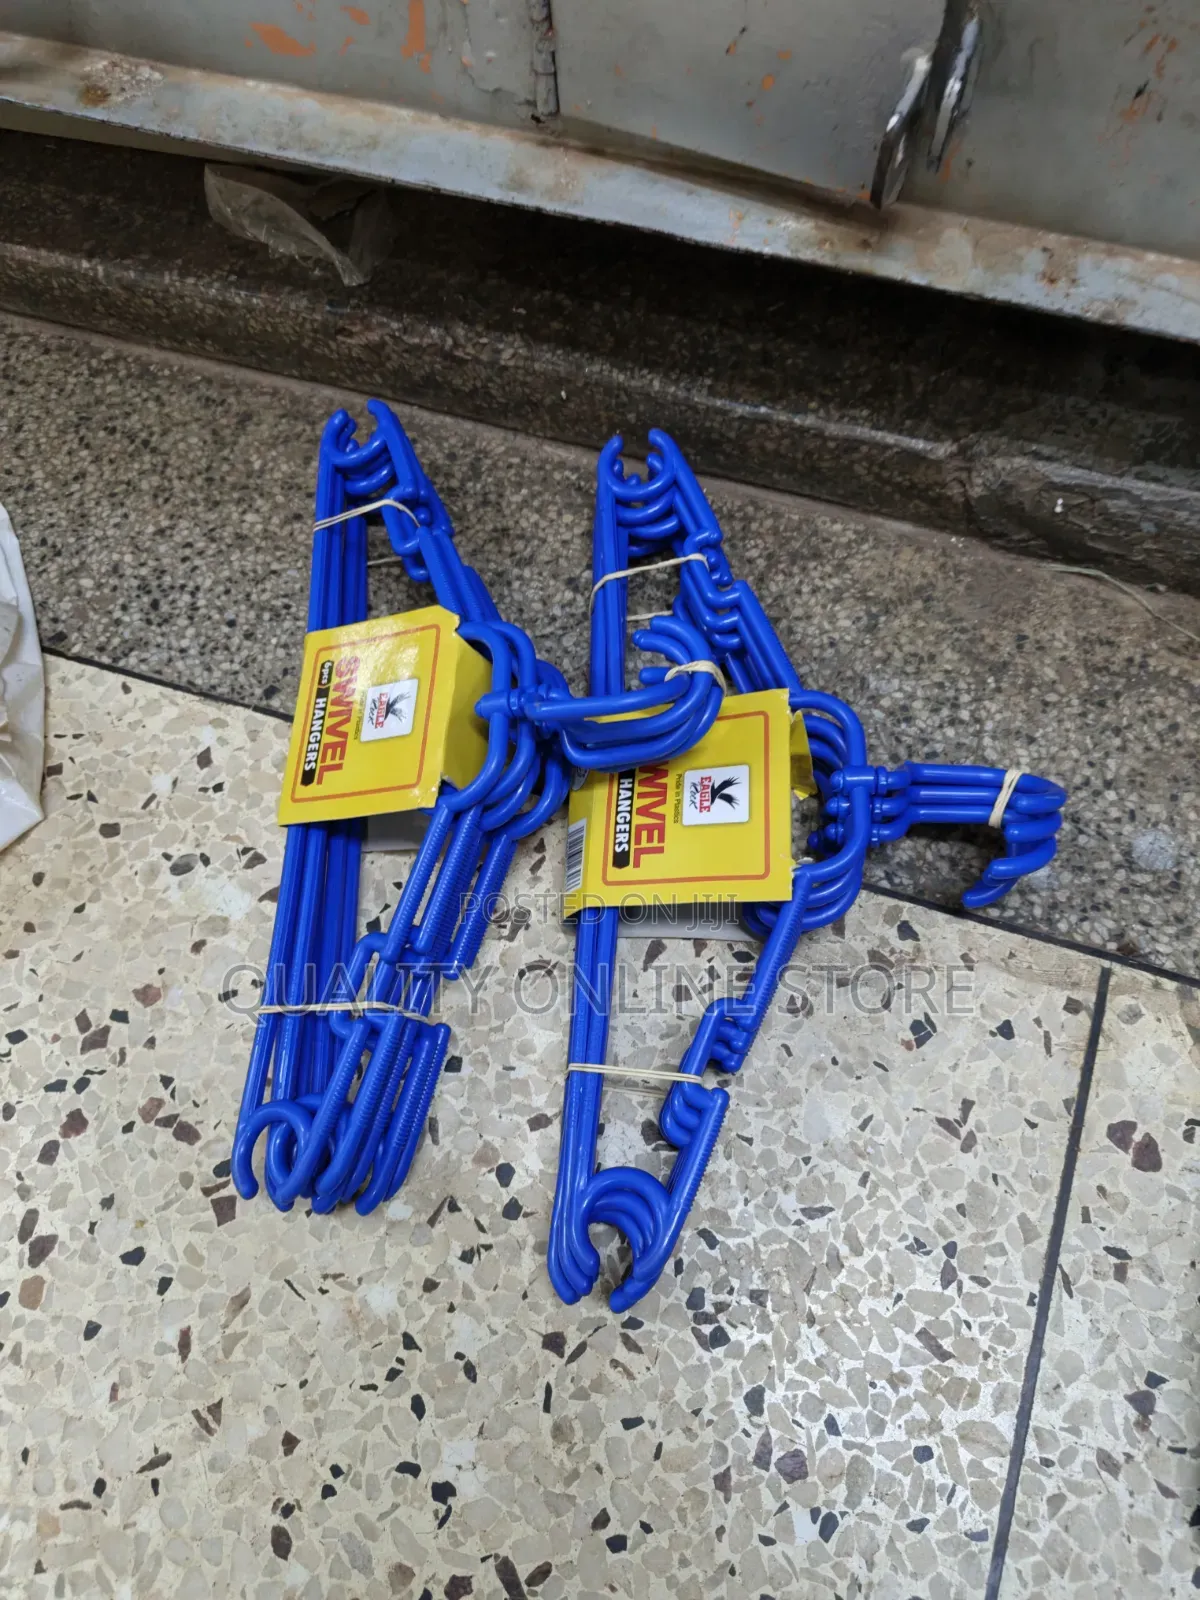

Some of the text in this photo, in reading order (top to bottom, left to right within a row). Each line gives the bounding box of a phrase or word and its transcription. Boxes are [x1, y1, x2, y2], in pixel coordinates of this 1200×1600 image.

[304, 661, 332, 771] 6pcs HANGERS
[316, 655, 361, 785] SWIVEL
[375, 692, 389, 729] EAGLE
[675, 773, 683, 791] Pride
[699, 776, 712, 813] EAGLE
[615, 778, 633, 853] HANGERS
[633, 760, 669, 869] WIVEL
[673, 798, 682, 824] Plastics
